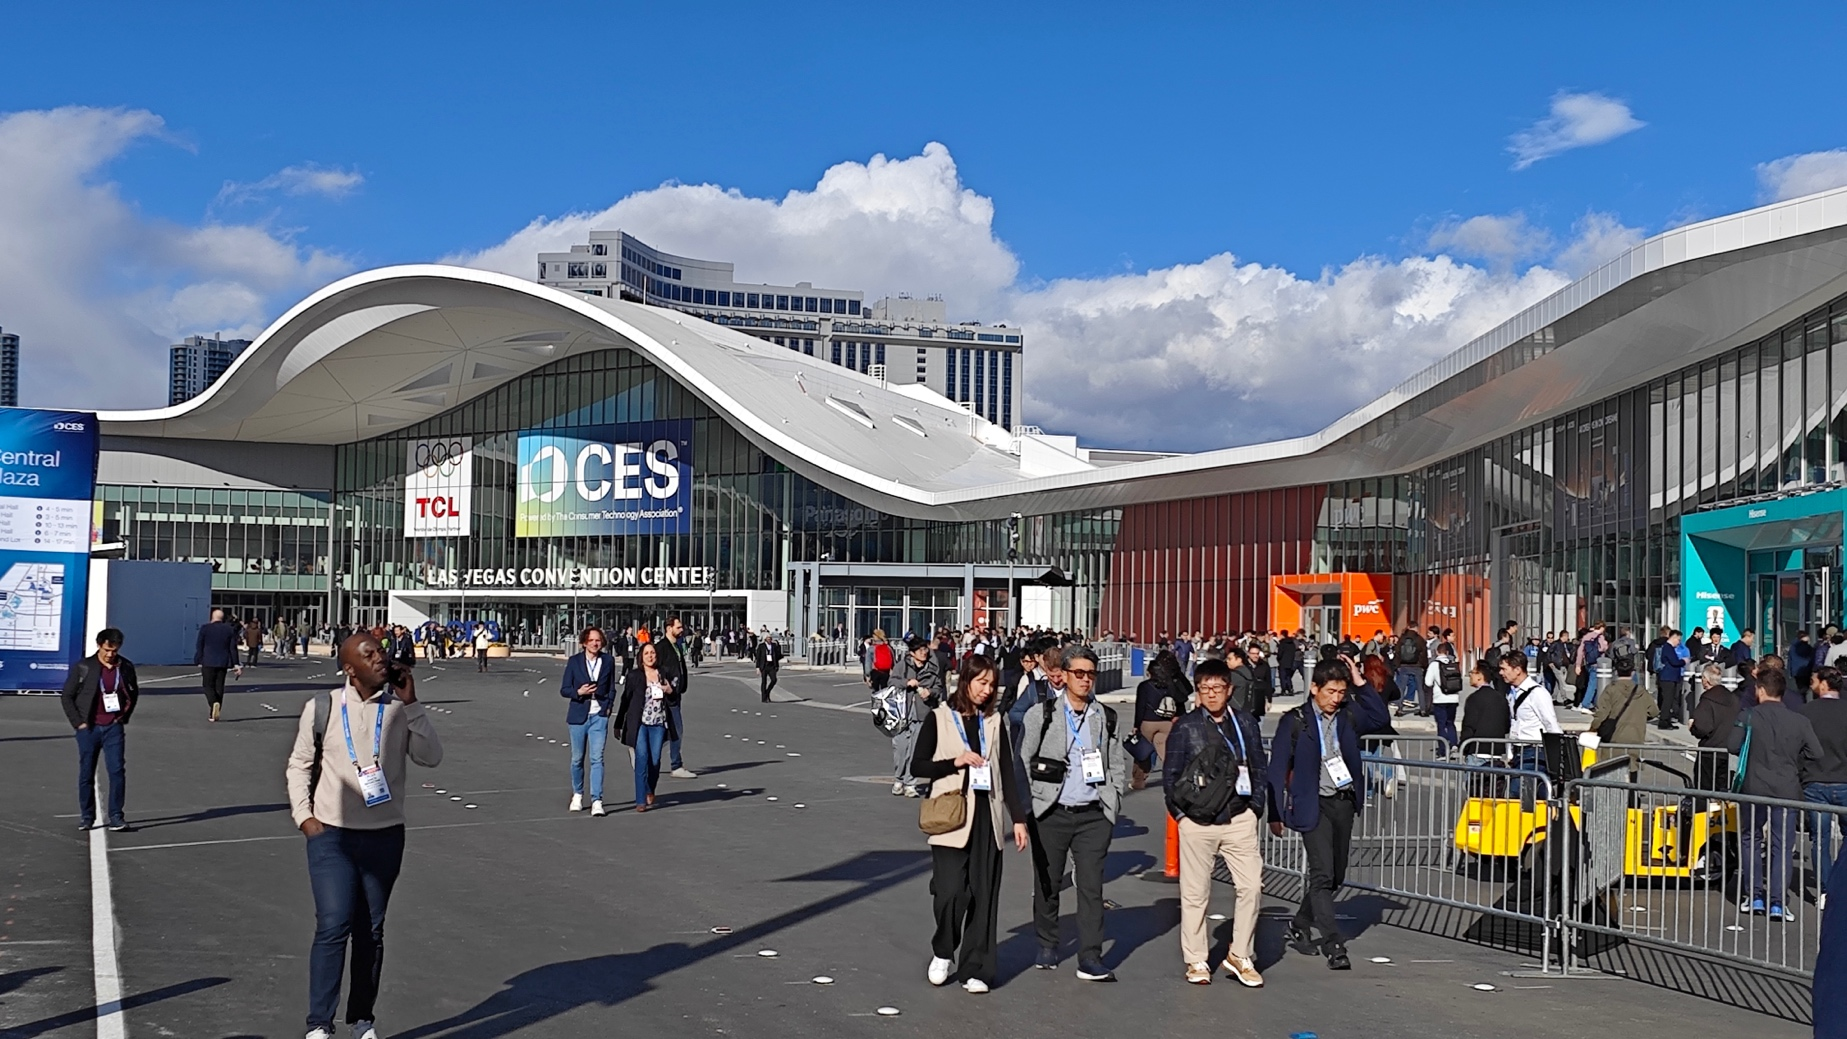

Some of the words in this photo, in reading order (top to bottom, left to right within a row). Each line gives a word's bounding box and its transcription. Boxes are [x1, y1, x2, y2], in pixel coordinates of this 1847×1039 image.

[65, 422, 85, 431] CES
[0, 450, 60, 467] entral
[0, 468, 40, 487] laza
[576, 440, 679, 502] CES
[416, 496, 460, 518] TCL
[602, 509, 639, 520] Technoogy
[427, 568, 458, 585] LAS
[463, 568, 516, 585] VEGAS
[520, 567, 637, 585] CONVENTION
[1353, 603, 1380, 616] pwc
